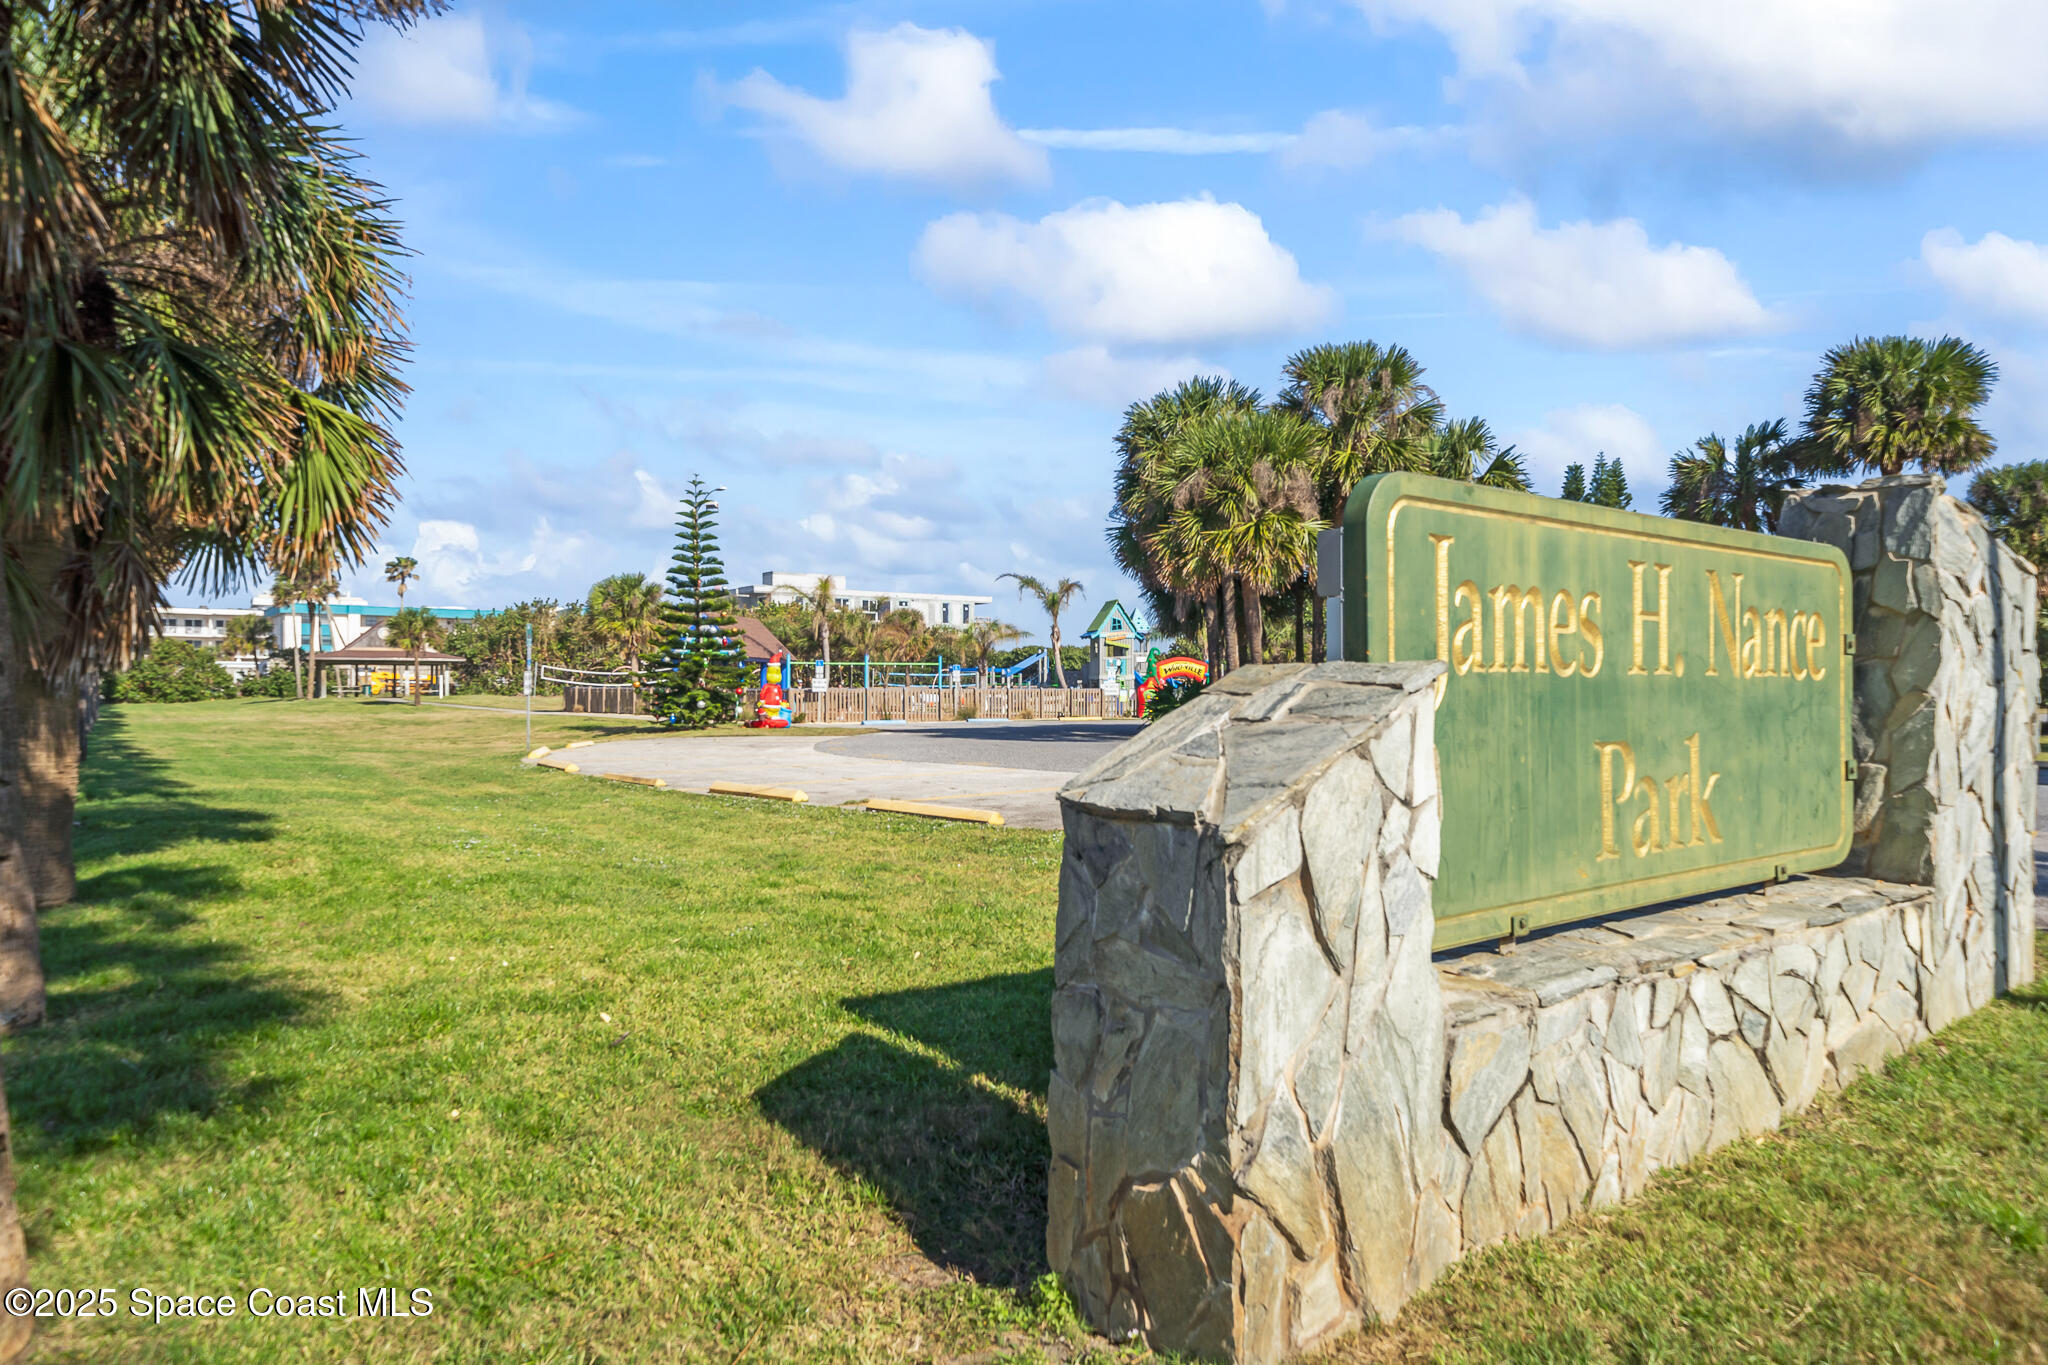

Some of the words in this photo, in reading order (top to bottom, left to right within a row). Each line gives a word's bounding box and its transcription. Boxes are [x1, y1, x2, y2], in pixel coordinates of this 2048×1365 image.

[1428, 532, 1604, 712] James
[1627, 559, 1685, 678] H.
[1704, 568, 1828, 682] Nance
[1594, 731, 1724, 862] Park
